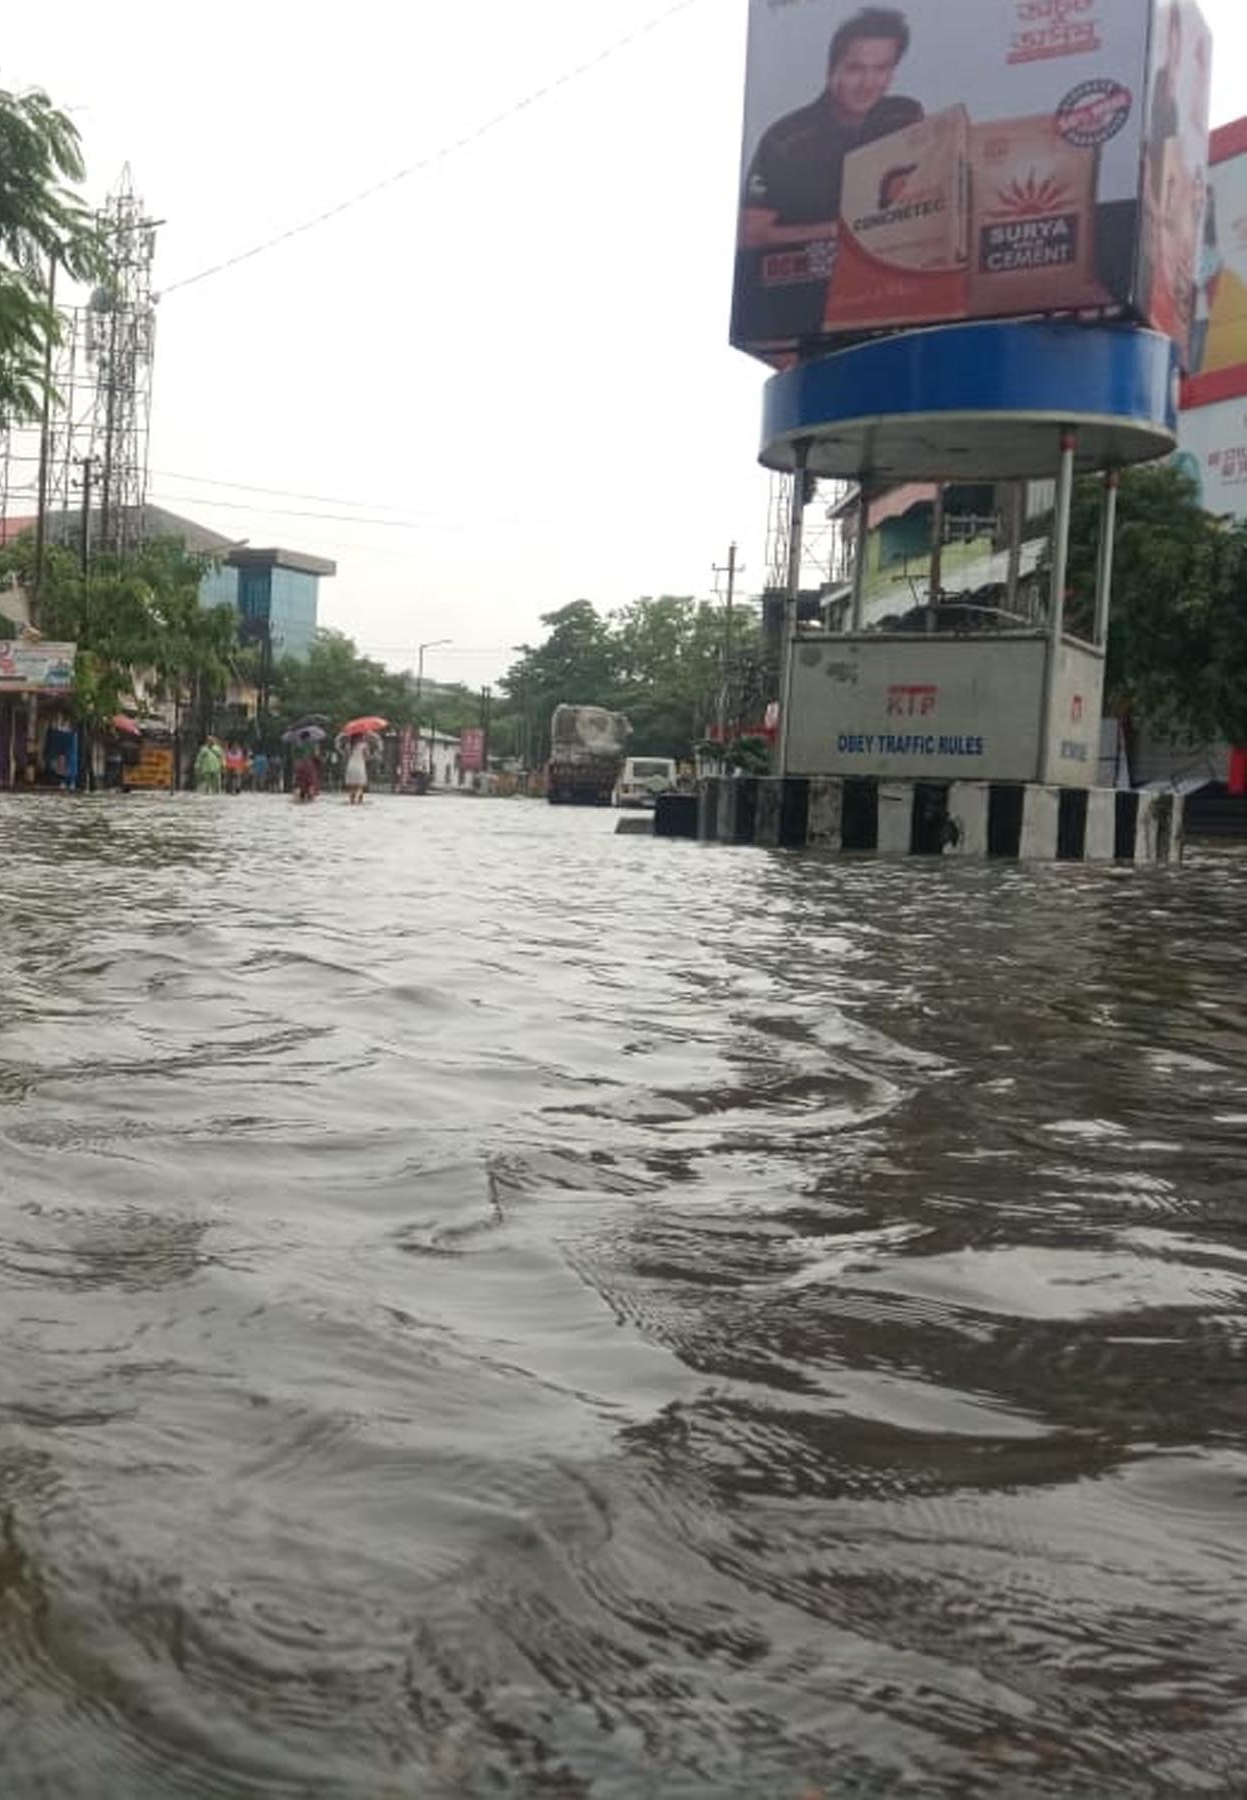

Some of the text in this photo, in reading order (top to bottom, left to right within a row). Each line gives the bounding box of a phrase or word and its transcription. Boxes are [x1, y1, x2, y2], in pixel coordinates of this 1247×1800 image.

[989, 217, 1069, 244] SURYA
[986, 243, 1069, 270] CEMENT
[837, 734, 985, 756] OBEY TRAFFIC RULES
